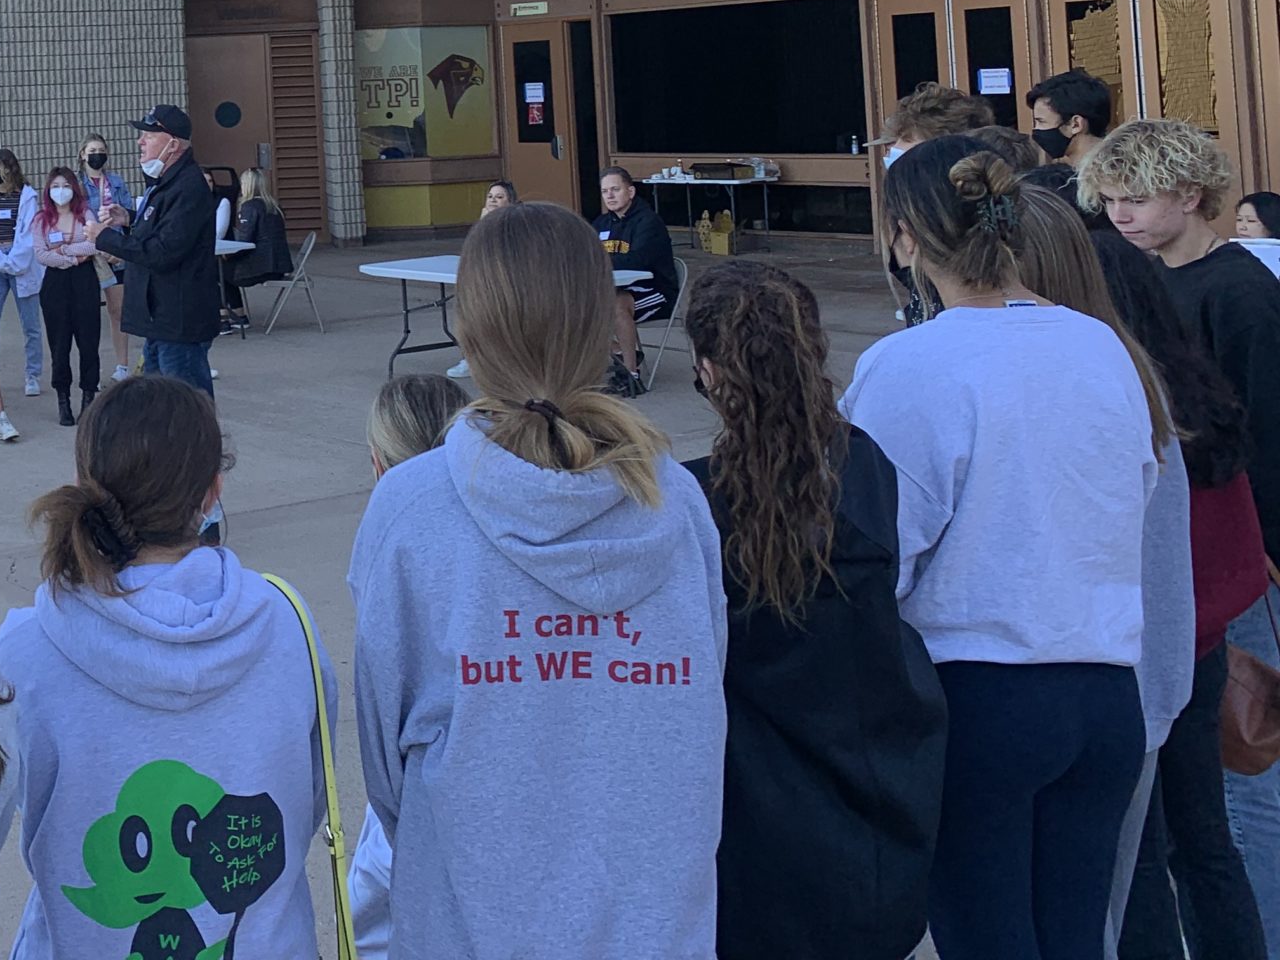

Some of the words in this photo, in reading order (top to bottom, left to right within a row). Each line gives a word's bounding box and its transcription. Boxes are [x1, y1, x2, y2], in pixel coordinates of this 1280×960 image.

[360, 66, 382, 78] WE
[389, 65, 418, 77] ARE
[360, 77, 419, 108] TP!
[503, 610, 520, 638] I
[534, 611, 641, 646] can't,
[460, 654, 522, 685] but
[535, 651, 592, 682] WE
[607, 657, 690, 685] can!
[227, 814, 248, 830] It
[251, 813, 262, 828] is
[227, 833, 263, 849] Okay
[209, 841, 224, 863] To
[226, 854, 255, 869] Ask
[222, 867, 261, 893] Help
[158, 934, 180, 951] W
